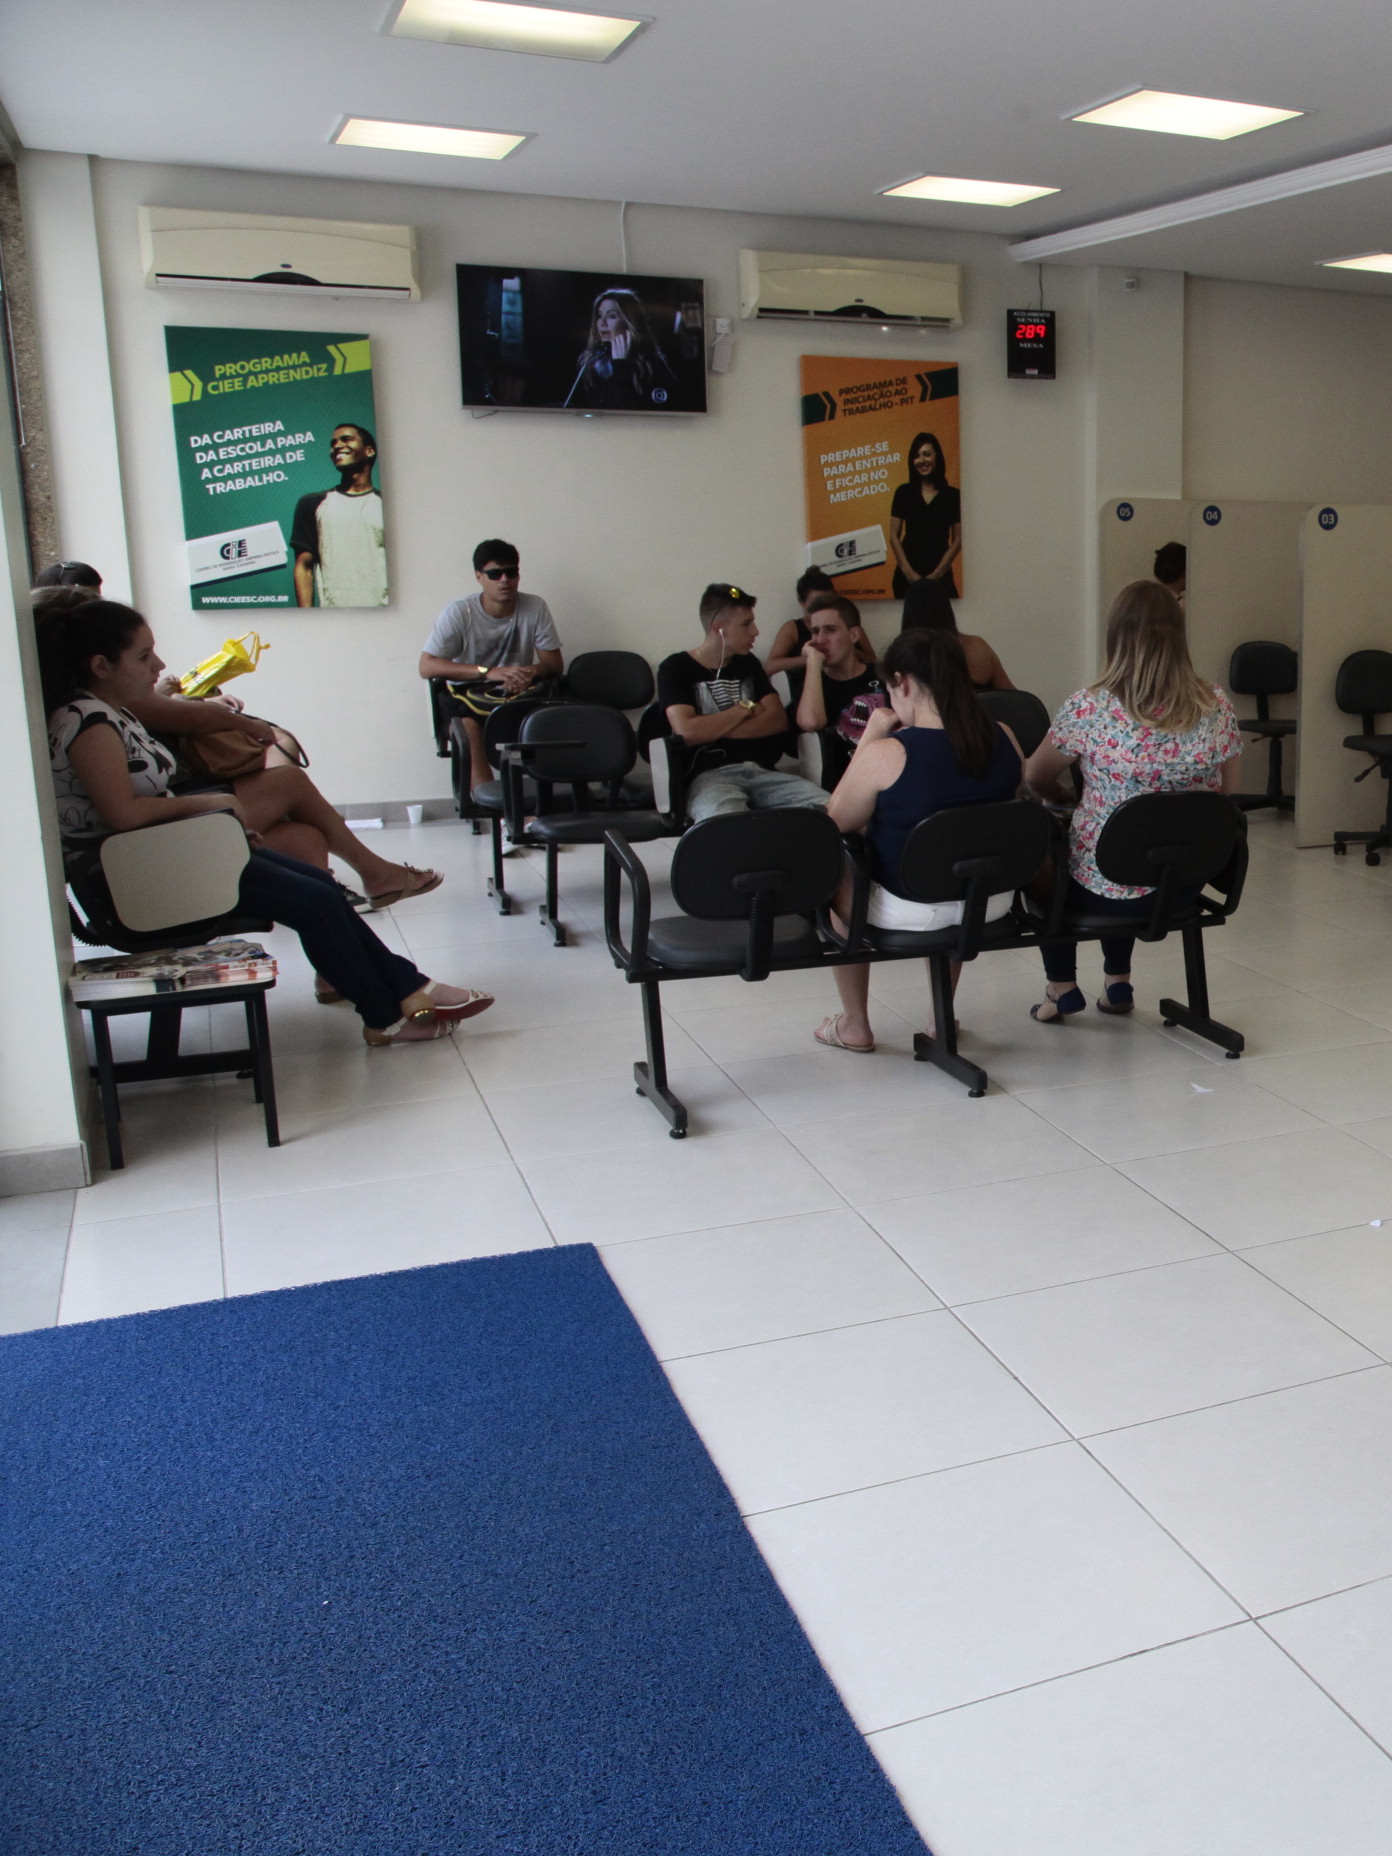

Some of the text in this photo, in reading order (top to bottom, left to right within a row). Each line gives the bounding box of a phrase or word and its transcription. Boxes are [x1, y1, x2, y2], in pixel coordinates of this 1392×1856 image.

[1016, 324, 1046, 339] 289
[214, 351, 311, 378] PROGRAMA
[207, 363, 328, 395] CIEE APRENDIZ
[838, 376, 908, 396] PROGRAMA DE
[842, 400, 894, 417] TRABALHO
[900, 396, 915, 406] PIT
[843, 387, 908, 406] INICIAÇÃO AO
[189, 420, 285, 448] DA CARTEIRA
[195, 431, 315, 464] DA ESCOLA PARA
[820, 441, 889, 465] PREPARE-SE
[201, 449, 306, 480] A CARTEIRA DE
[824, 452, 901, 478] PARA ENTRAR
[206, 470, 288, 496] TRABALHO.
[826, 469, 888, 491] E FICAR NO
[829, 482, 890, 504] MERCADO.
[1120, 508, 1131, 517] 05
[1206, 511, 1218, 520] 04
[1321, 514, 1335, 525] 03
[201, 595, 289, 604] WWW.CIEESC.ORG.BR
